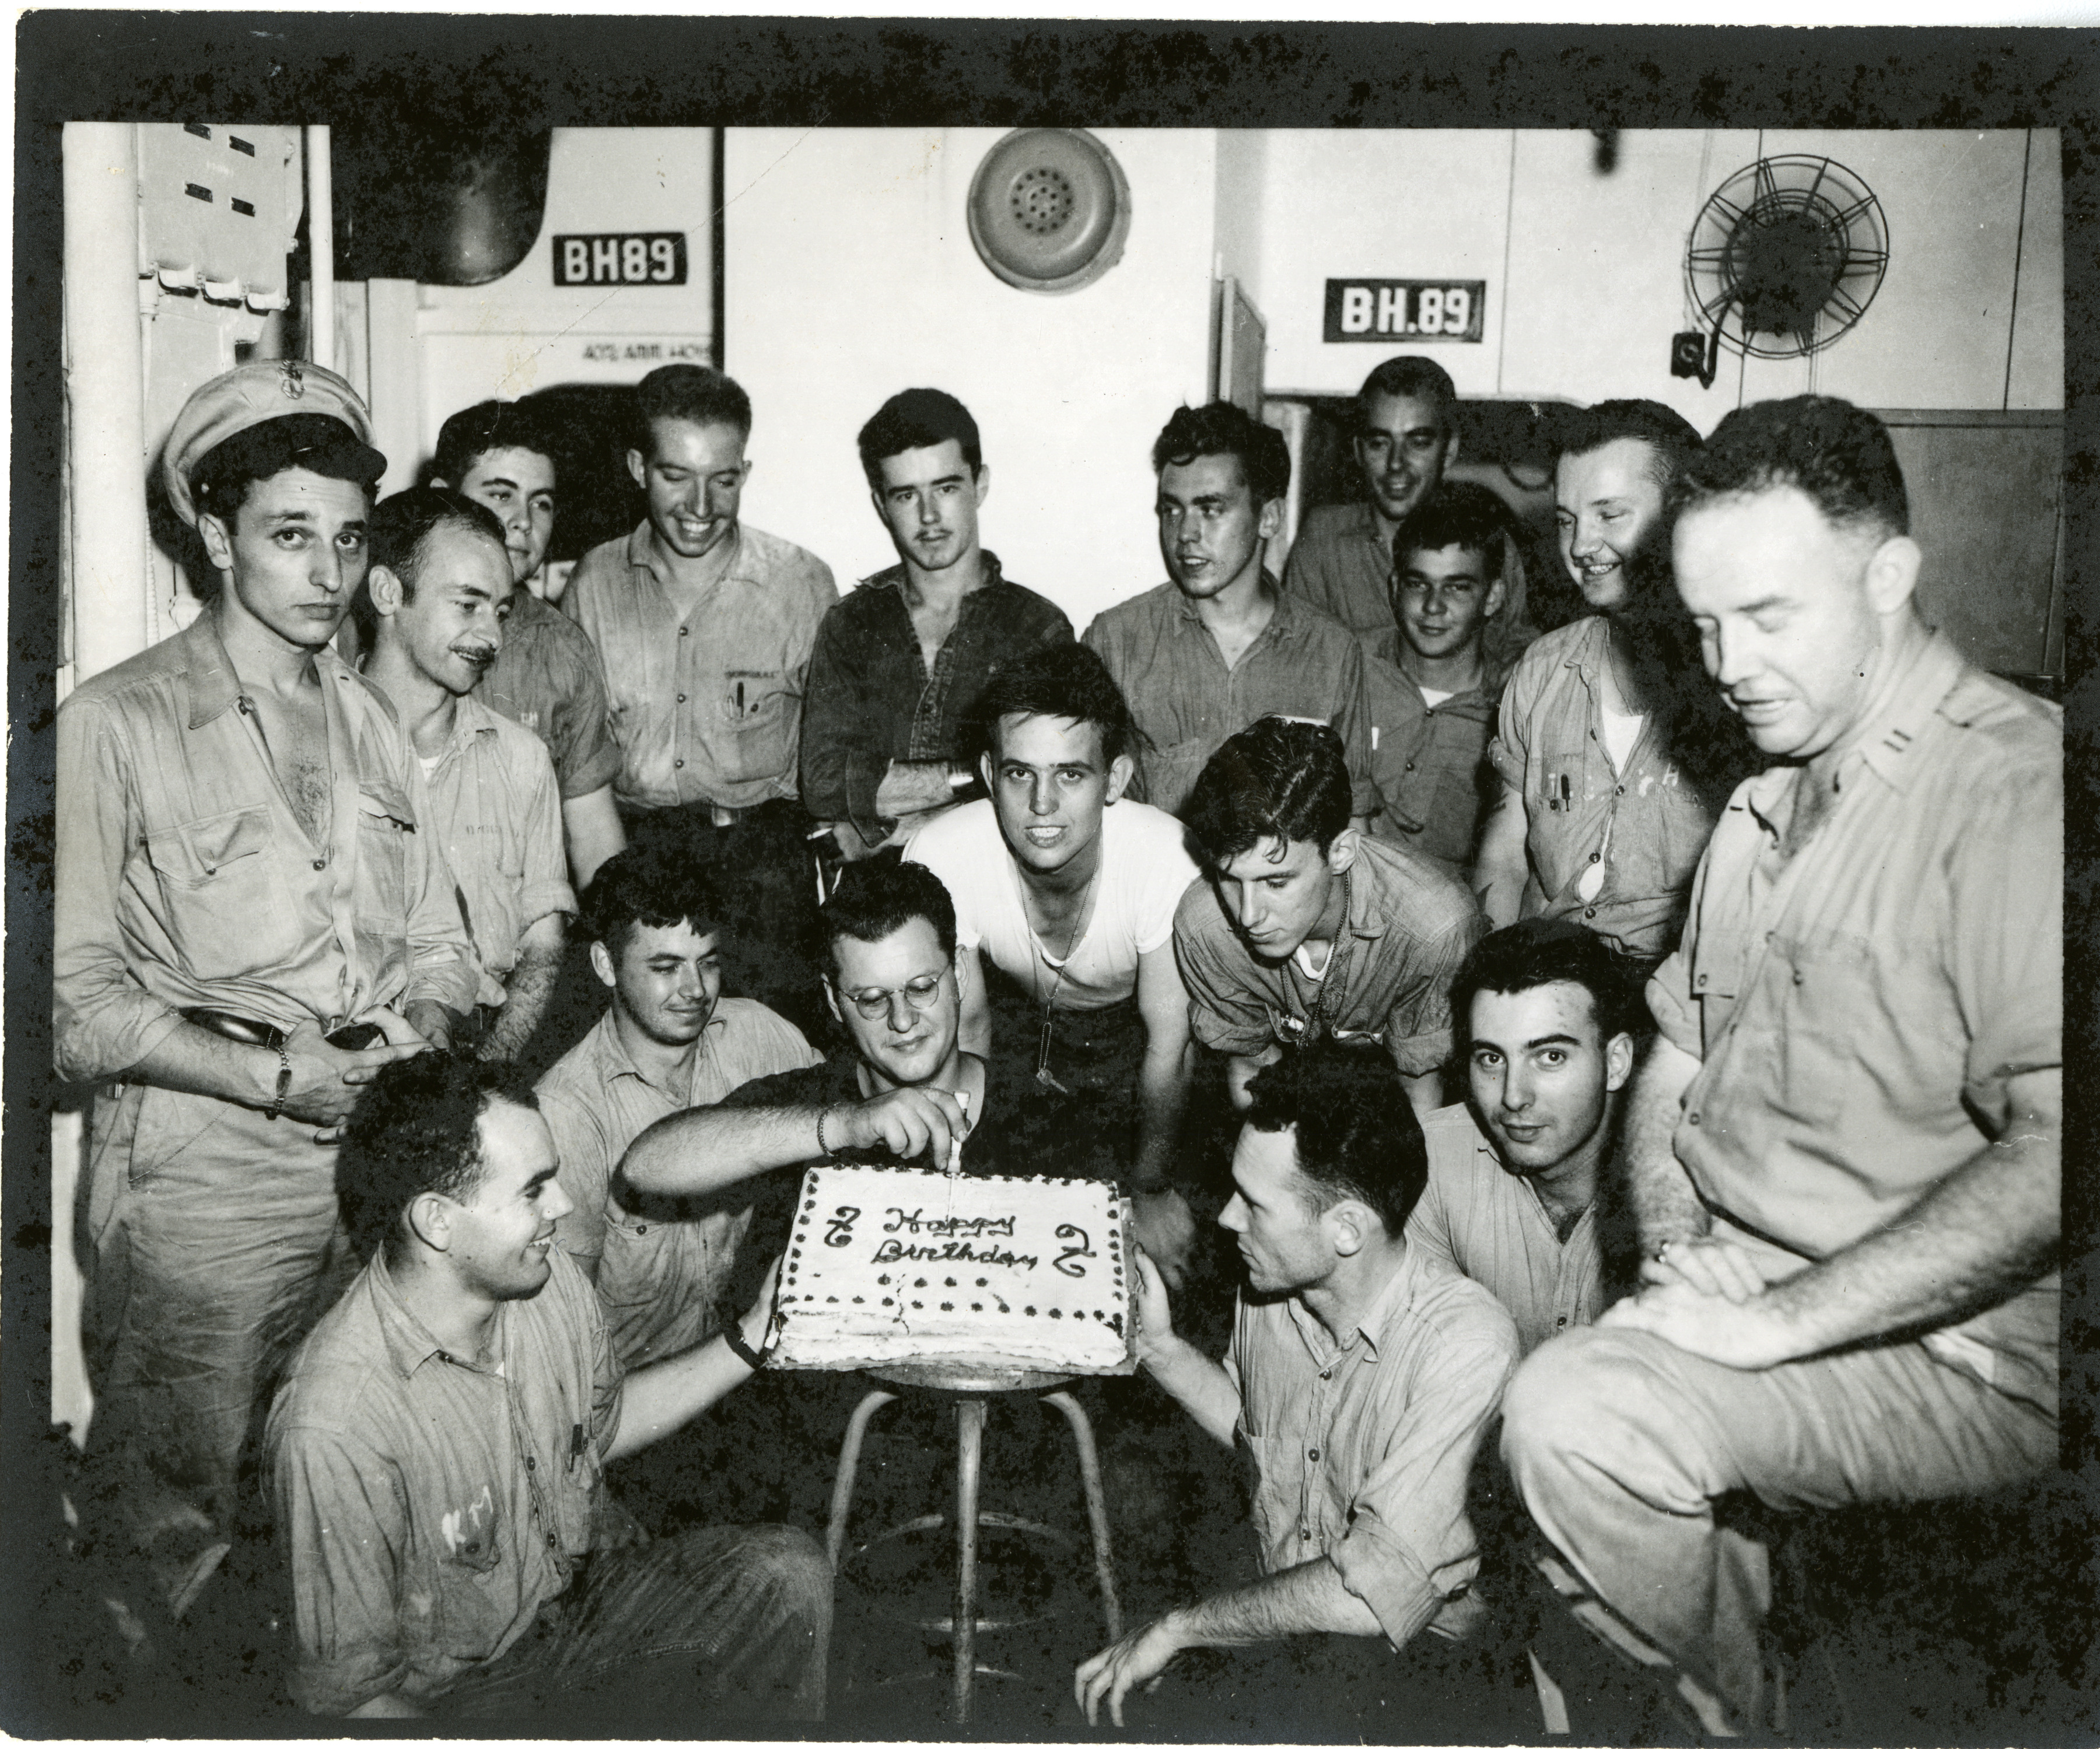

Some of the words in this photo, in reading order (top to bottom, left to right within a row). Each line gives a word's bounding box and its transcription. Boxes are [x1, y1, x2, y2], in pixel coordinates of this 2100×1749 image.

[564, 238, 675, 282] BH89
[1342, 288, 1470, 334] BH.89
[883, 1207, 1017, 1237] Happy
[870, 1239, 1038, 1271] Birthday
